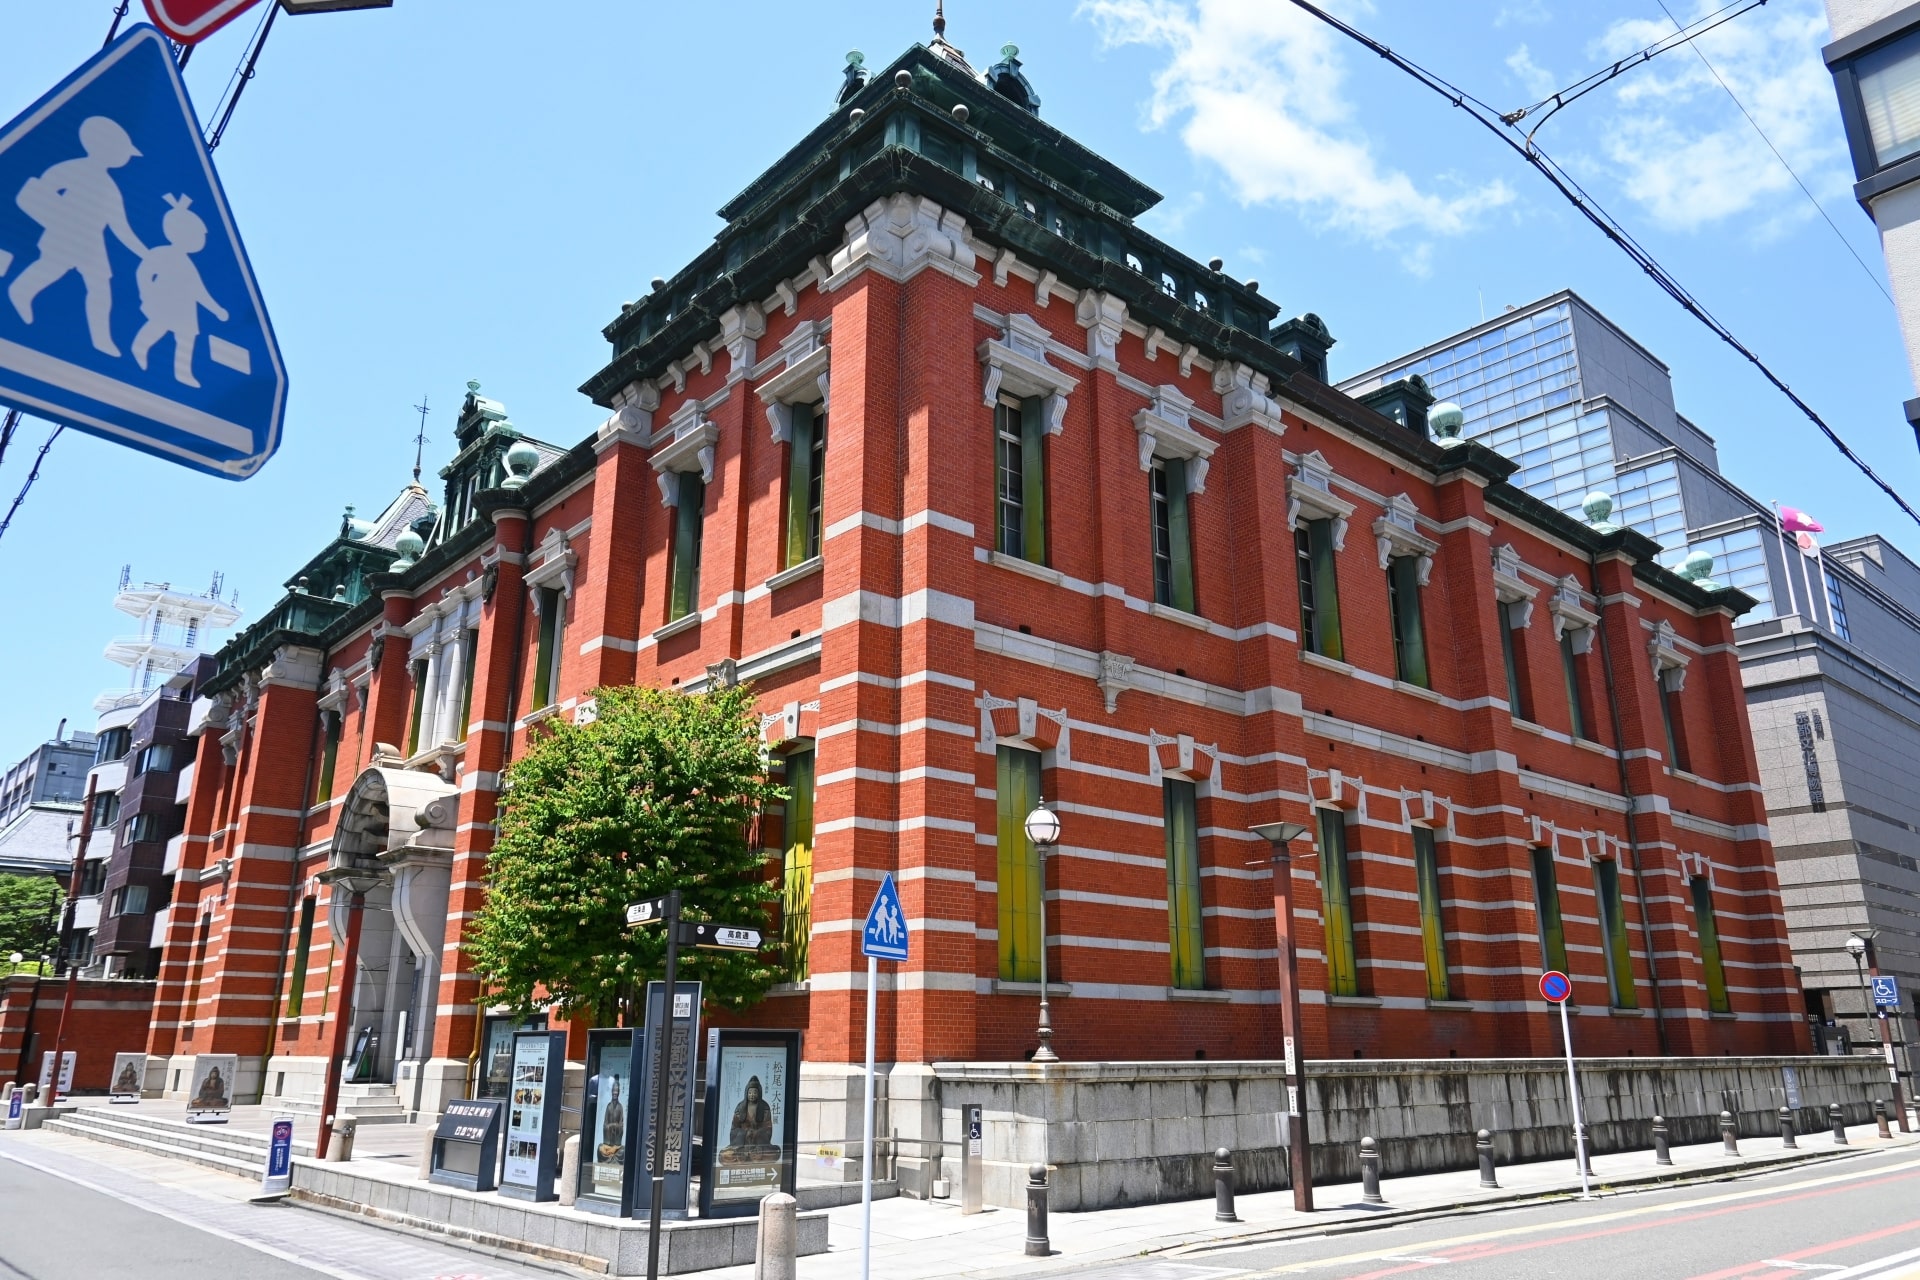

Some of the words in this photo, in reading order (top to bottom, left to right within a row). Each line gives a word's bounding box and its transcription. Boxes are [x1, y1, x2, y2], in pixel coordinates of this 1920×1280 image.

[1794, 711, 1824, 804] 京都文化博物館
[728, 930, 749, 939] 高倉通
[663, 1022, 690, 1172] 京都文化博物館
[645, 1131, 657, 1172] Kyoto
